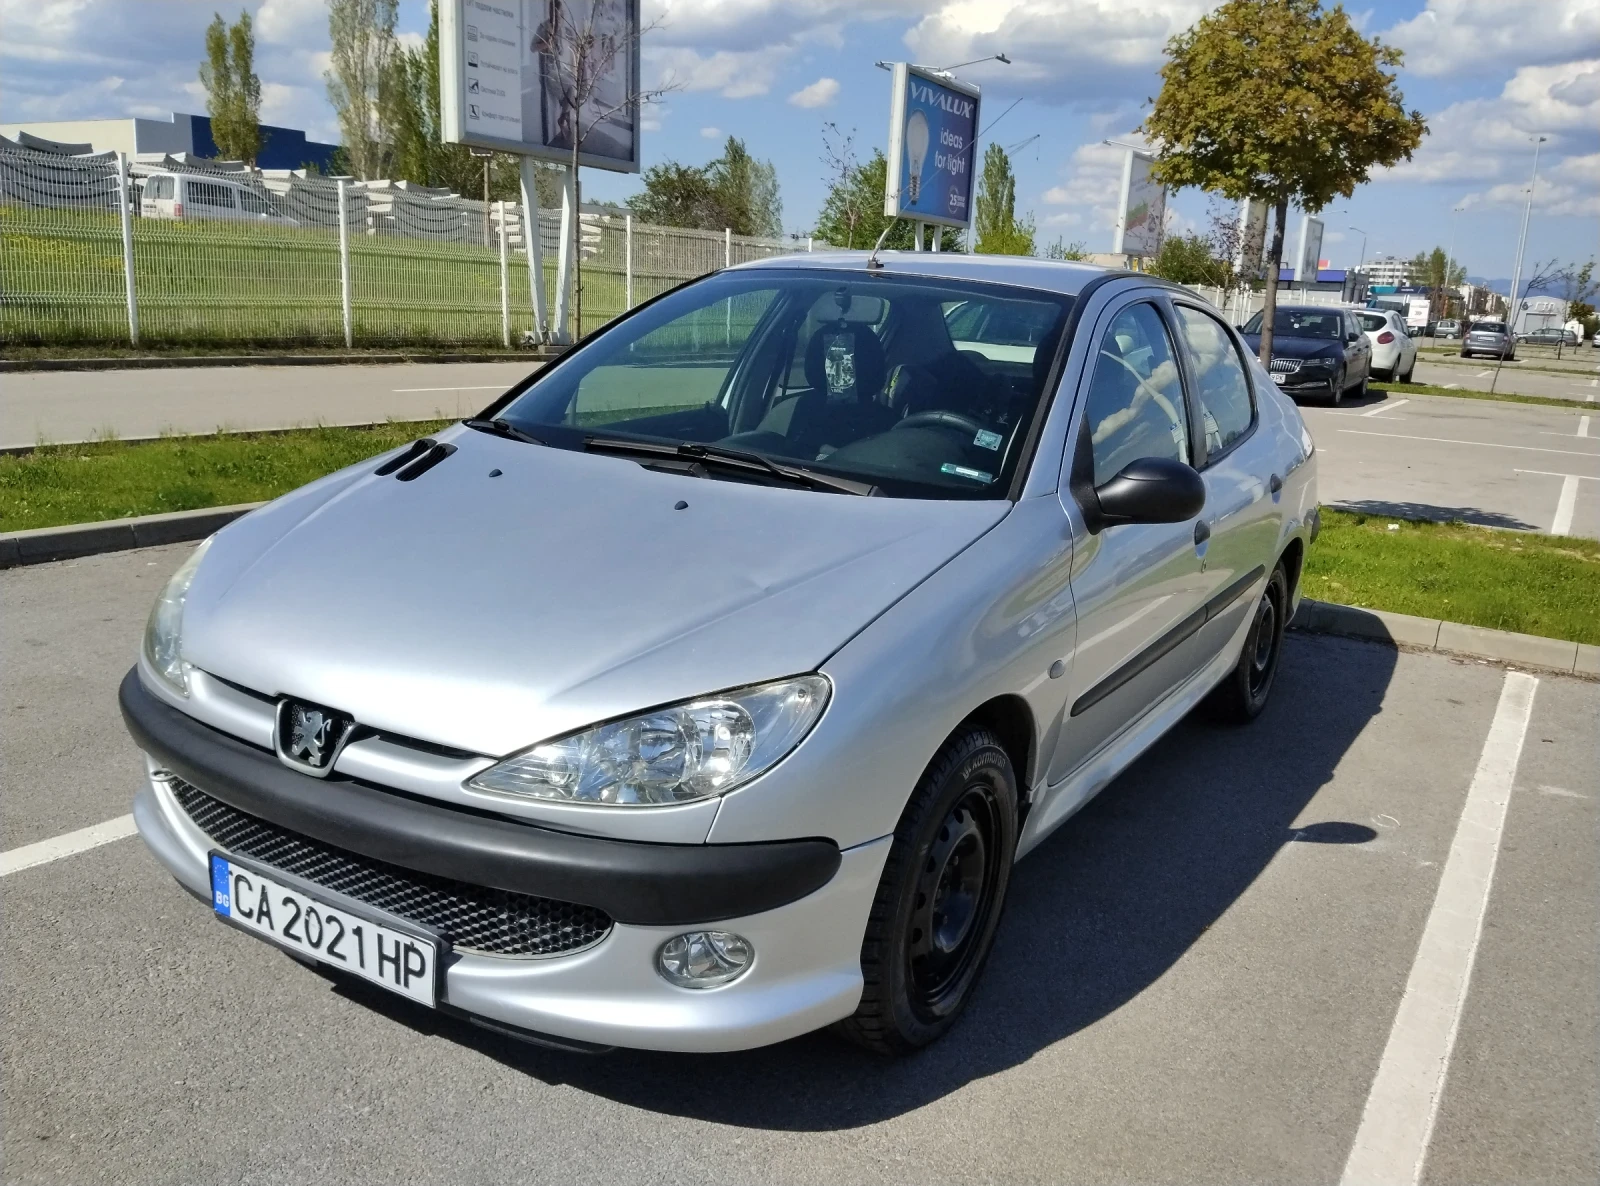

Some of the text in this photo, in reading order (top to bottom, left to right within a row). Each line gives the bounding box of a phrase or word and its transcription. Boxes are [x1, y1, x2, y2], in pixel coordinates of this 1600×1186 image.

[910, 81, 971, 118] VIVALUX
[940, 127, 963, 149] ideas
[934, 150, 965, 175] for light
[949, 193, 958, 206] 25
[215, 890, 230, 908] BG
[282, 896, 365, 969] 2021
